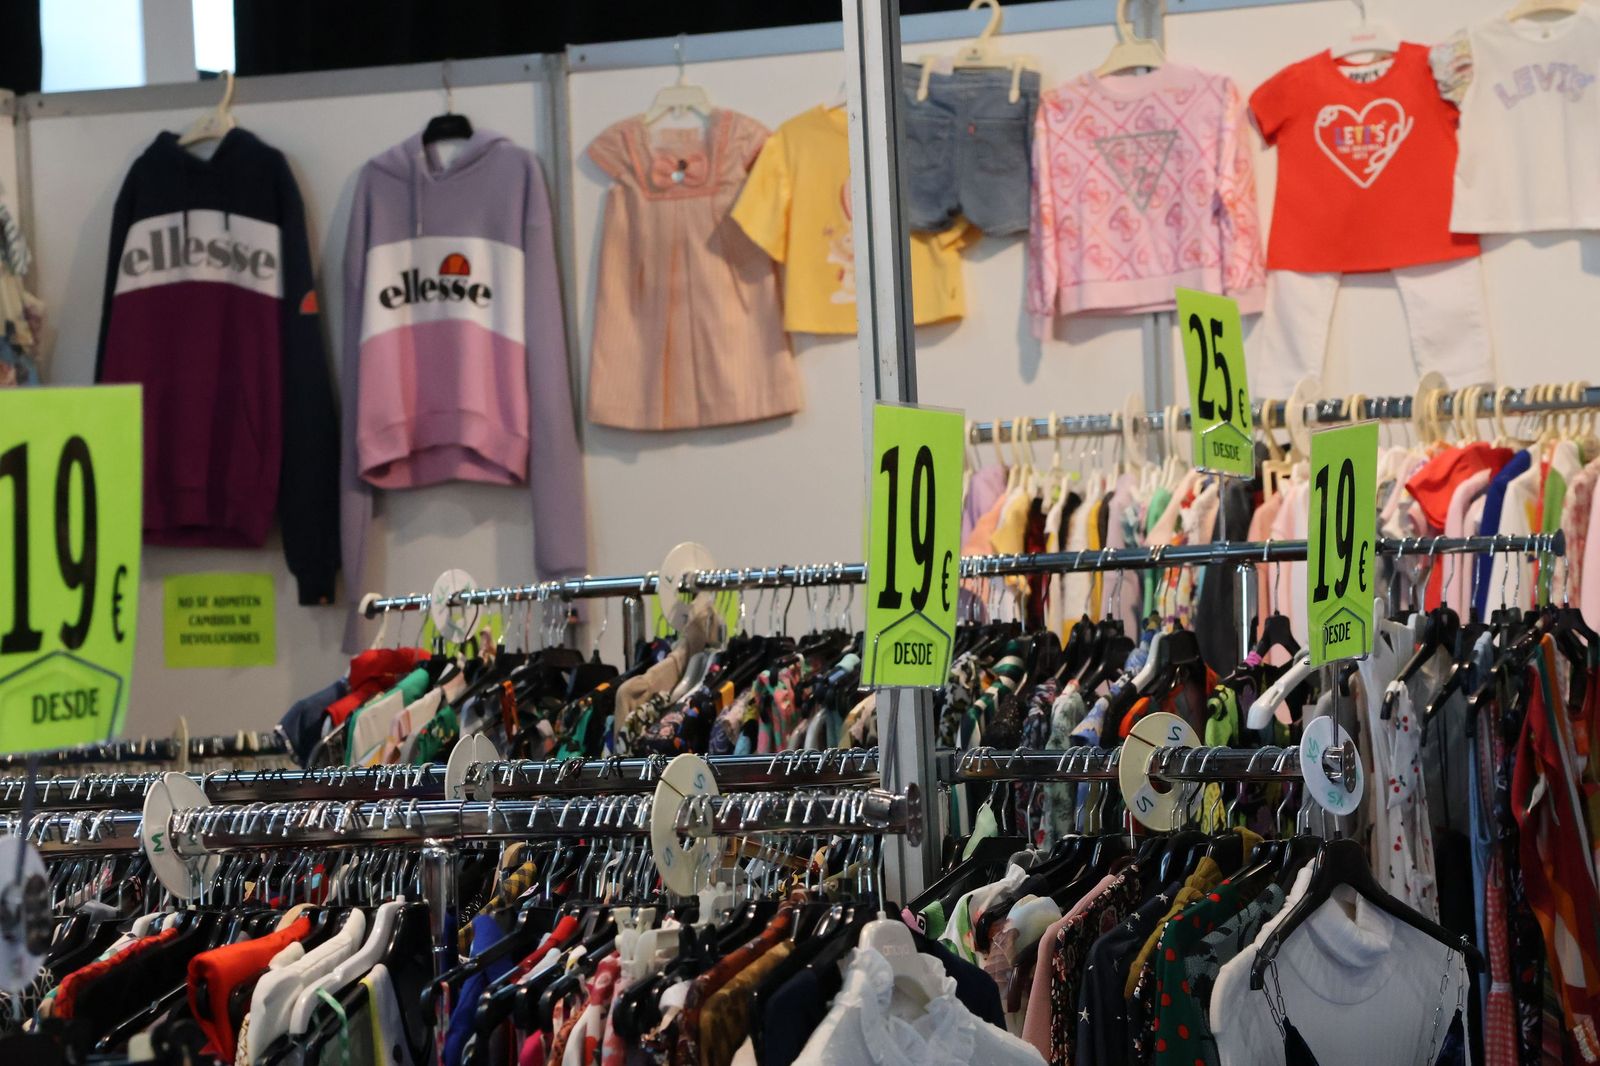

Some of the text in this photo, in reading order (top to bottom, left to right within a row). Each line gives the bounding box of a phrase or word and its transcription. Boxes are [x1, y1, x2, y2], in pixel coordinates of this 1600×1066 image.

[122, 226, 277, 280] ellesse
[379, 267, 493, 310] ellesse
[1213, 440, 1241, 461] DESDE
[894, 642, 933, 666] DESDE
[32, 688, 99, 725] DESDE
